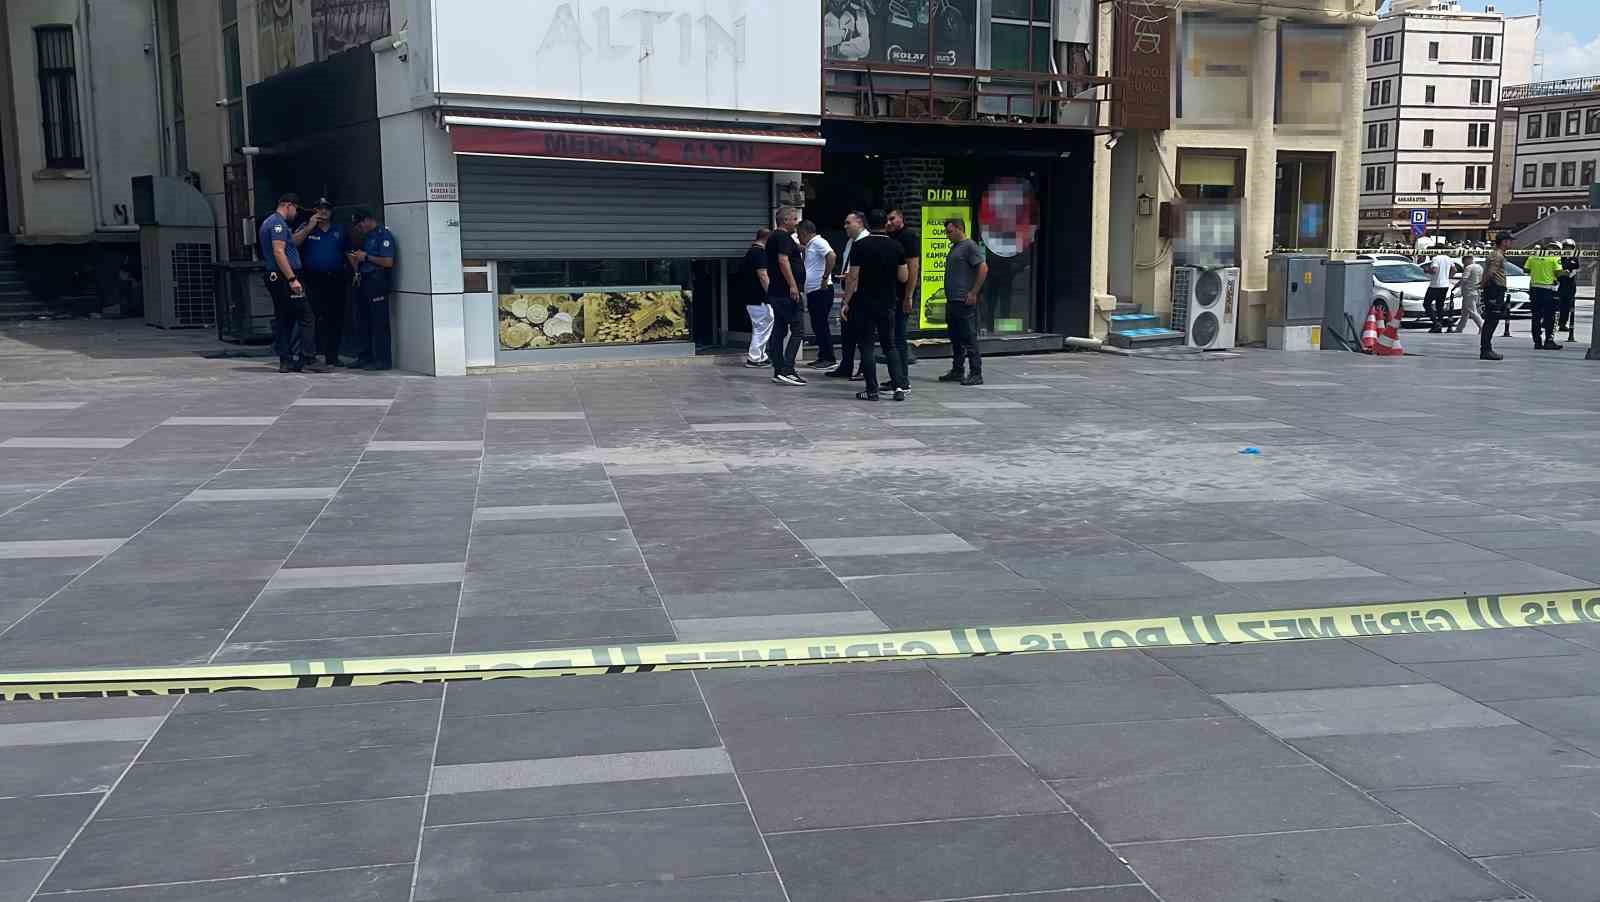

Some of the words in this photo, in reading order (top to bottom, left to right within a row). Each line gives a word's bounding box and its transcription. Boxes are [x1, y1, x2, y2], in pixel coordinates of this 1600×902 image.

[536, 3, 746, 65] ALTIN
[543, 133, 658, 161] MERKEZ
[682, 141, 755, 163] ALTIN
[928, 188, 953, 201] DUR
[1416, 212, 1423, 221] D
